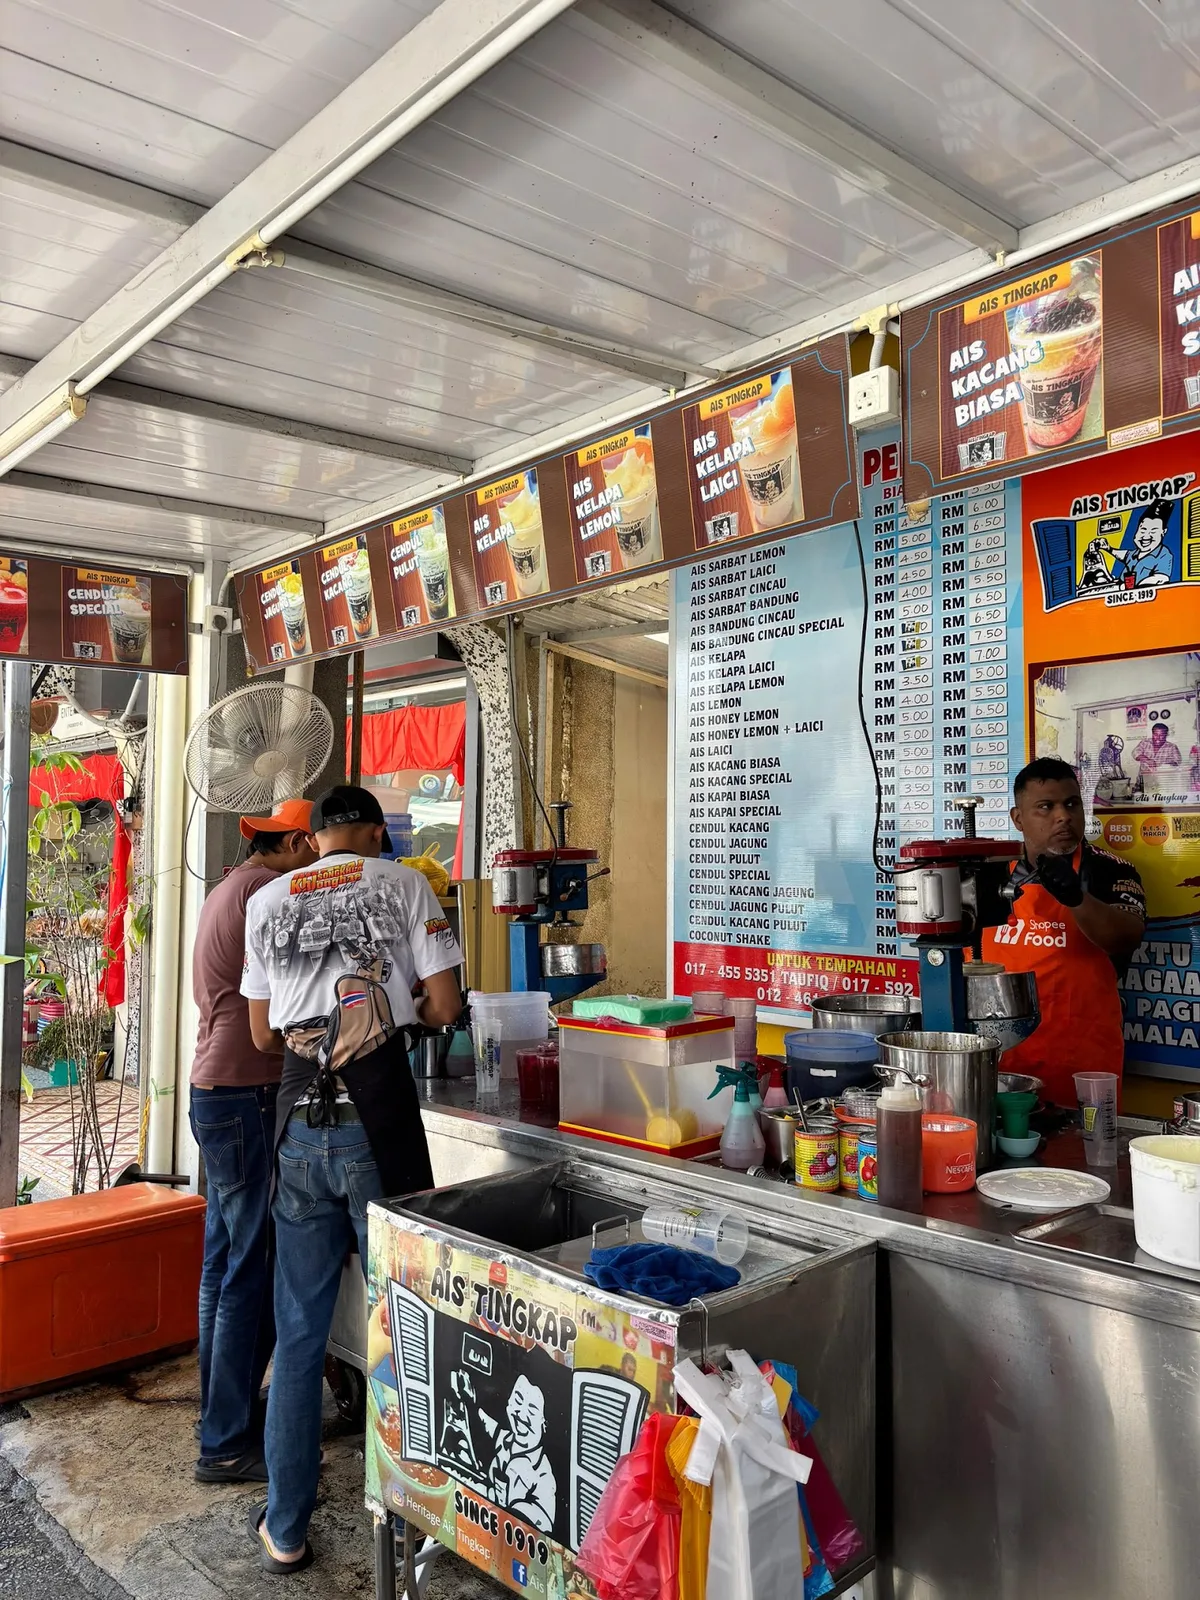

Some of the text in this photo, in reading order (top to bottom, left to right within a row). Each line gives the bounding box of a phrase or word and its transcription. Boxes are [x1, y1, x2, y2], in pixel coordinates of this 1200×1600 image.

[979, 274, 1058, 315] AIS TINGKAP
[950, 340, 987, 373] AIS
[952, 341, 1044, 399] KACANG
[1046, 372, 1085, 391] TINGKAP
[710, 383, 763, 413] AIS TINGKAP
[955, 382, 1024, 427] BIASA
[586, 437, 628, 461] AIS TINGKAP
[693, 430, 719, 457] AIS
[696, 436, 755, 480] KELAPA
[484, 479, 519, 500] AIS TINGKAP
[573, 476, 593, 499] AIS
[700, 469, 740, 502] LAICI
[576, 483, 624, 520] KELAPA
[1072, 477, 1187, 516] AIS TINGKAP
[399, 514, 429, 531] AIS TINGKAP
[473, 513, 490, 535] AIS
[579, 507, 623, 542] LEMON
[476, 521, 515, 552] KELAPA
[875, 538, 894, 552] RM
[328, 542, 354, 557] AIS TINGKAP
[391, 534, 423, 562] CENDUL
[942, 542, 964, 556] RM
[394, 556, 421, 579] PULUT
[691, 546, 786, 576] AIS SARBAT LEMON
[86, 572, 130, 584] AIS TINGKAP
[321, 561, 350, 585] CENDUL
[691, 564, 776, 591] AIS SARBAT LAICI
[68, 588, 118, 600] CENDUL
[261, 581, 285, 605] CENDUL
[323, 577, 353, 601] KACANG
[691, 578, 787, 606] AIS SARBAT CINCAU
[943, 578, 964, 592] RM
[691, 592, 799, 622] AIS SARBAT BANDUNG
[1107, 589, 1153, 604] SINCE 1919
[70, 604, 123, 615] SPECIAL
[264, 597, 289, 620] JAGUNG
[691, 609, 795, 637] AIS BANDUNG CINCAU
[691, 618, 844, 652] AIS BANDUNG CINCAU SPECIAL
[943, 633, 965, 646] RM
[691, 650, 745, 667] AIS KELAPA
[691, 661, 775, 682] AIS KELAPA LAICI
[690, 676, 784, 697] AIS KELAPA LEMON
[690, 698, 741, 712] AIS LEMON
[690, 709, 779, 727] AIS HONEY LEMON
[690, 732, 705, 742] AIS
[708, 729, 739, 741] HONEY
[744, 725, 779, 738] LEMON
[795, 721, 823, 732] LAICI
[690, 745, 732, 757] AIS LAICI
[690, 757, 780, 772] AIS KACANG BIASA
[690, 773, 792, 787] AIS KACANG SPECIAL
[690, 790, 770, 803] AIS KAPAI BIASA
[690, 806, 781, 818] AIS KAPAI SPECIAL
[690, 822, 769, 833] CENDUL KACANG
[690, 838, 767, 848] CENDUL JAGUNG
[690, 854, 760, 864] CENDUL PULUT
[690, 869, 770, 880] CENDUL SPECIAL
[690, 884, 814, 898] CENDUL KACANG JAGUNG
[690, 900, 804, 915] CENDUL JAGUNG PULUT
[690, 915, 807, 931] CENDUL KACANG PULUT
[1029, 919, 1066, 931] Shopee
[690, 931, 770, 945] COCONUT SHAKE
[1024, 932, 1067, 948] Food
[767, 952, 897, 977] UNTUK TEMPAHAN
[685, 962, 706, 976] 017
[718, 965, 740, 979] 455
[745, 966, 774, 982] 5351
[781, 971, 829, 991] TAUFIQ
[842, 977, 869, 993] 017
[756, 987, 781, 1002] 012
[430, 1266, 467, 1308] AIS
[474, 1281, 578, 1352] TINGKAP
[406, 1494, 491, 1560] Heritage Ais Tingkap
[454, 1491, 548, 1566] SINCE 1919
[528, 1575, 545, 1594] Ais
